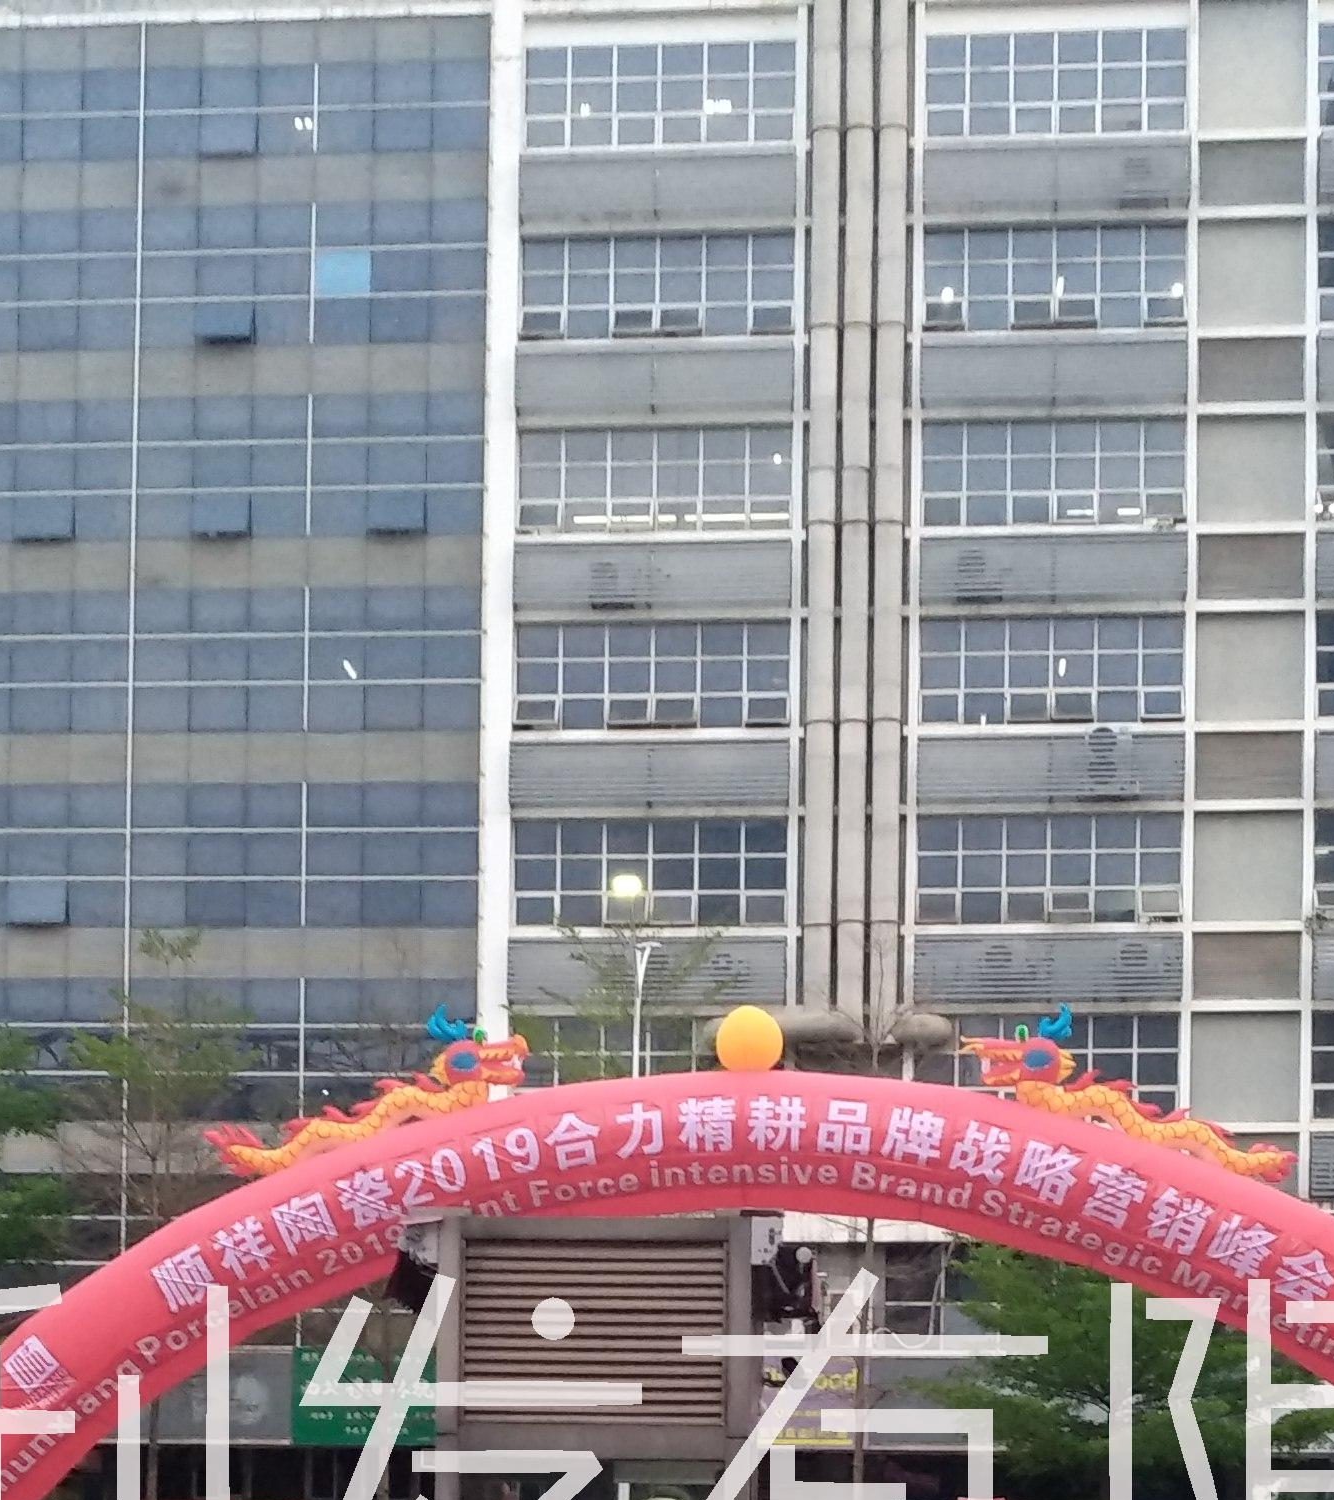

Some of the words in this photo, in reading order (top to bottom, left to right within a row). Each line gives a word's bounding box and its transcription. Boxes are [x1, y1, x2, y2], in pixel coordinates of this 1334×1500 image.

[134, 1266, 315, 1366] Porcelain
[528, 1170, 640, 1209] Force
[649, 1156, 840, 1191] intensive
[851, 1161, 972, 1210] Brand
[979, 1189, 1164, 1276] Strategic
